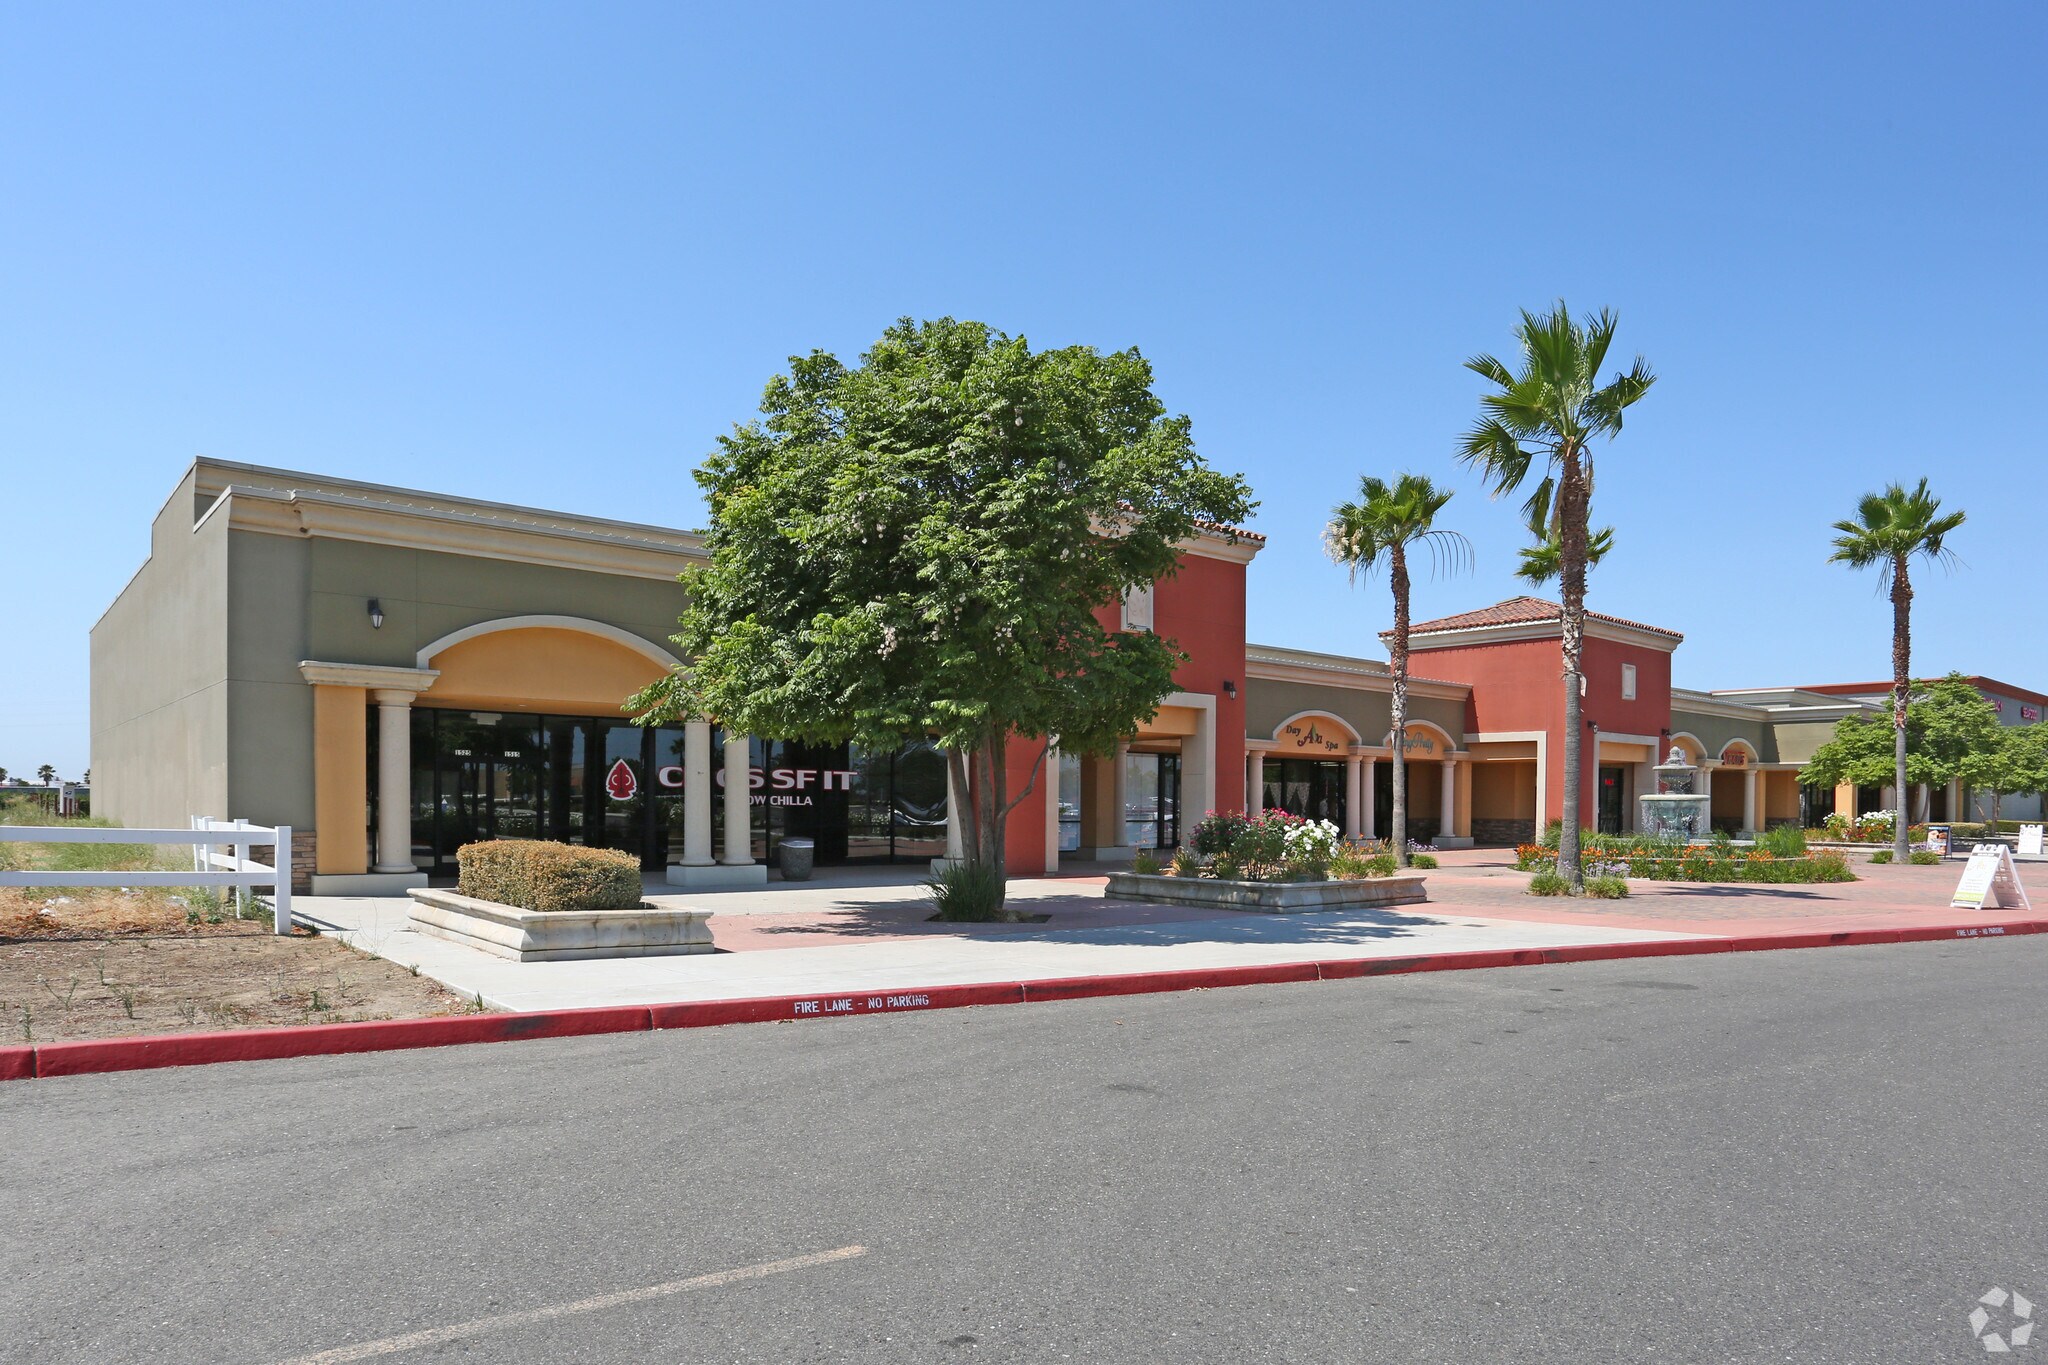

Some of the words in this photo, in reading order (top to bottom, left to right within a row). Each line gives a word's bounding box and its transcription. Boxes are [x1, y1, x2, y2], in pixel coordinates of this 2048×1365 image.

[1286, 724, 1301, 736] Day
[770, 795, 813, 806] CHILLA
[794, 1001, 820, 1014] FIRE
[825, 998, 853, 1012] LANE
[868, 997, 883, 1009] NO
[887, 994, 929, 1007] PARKING
